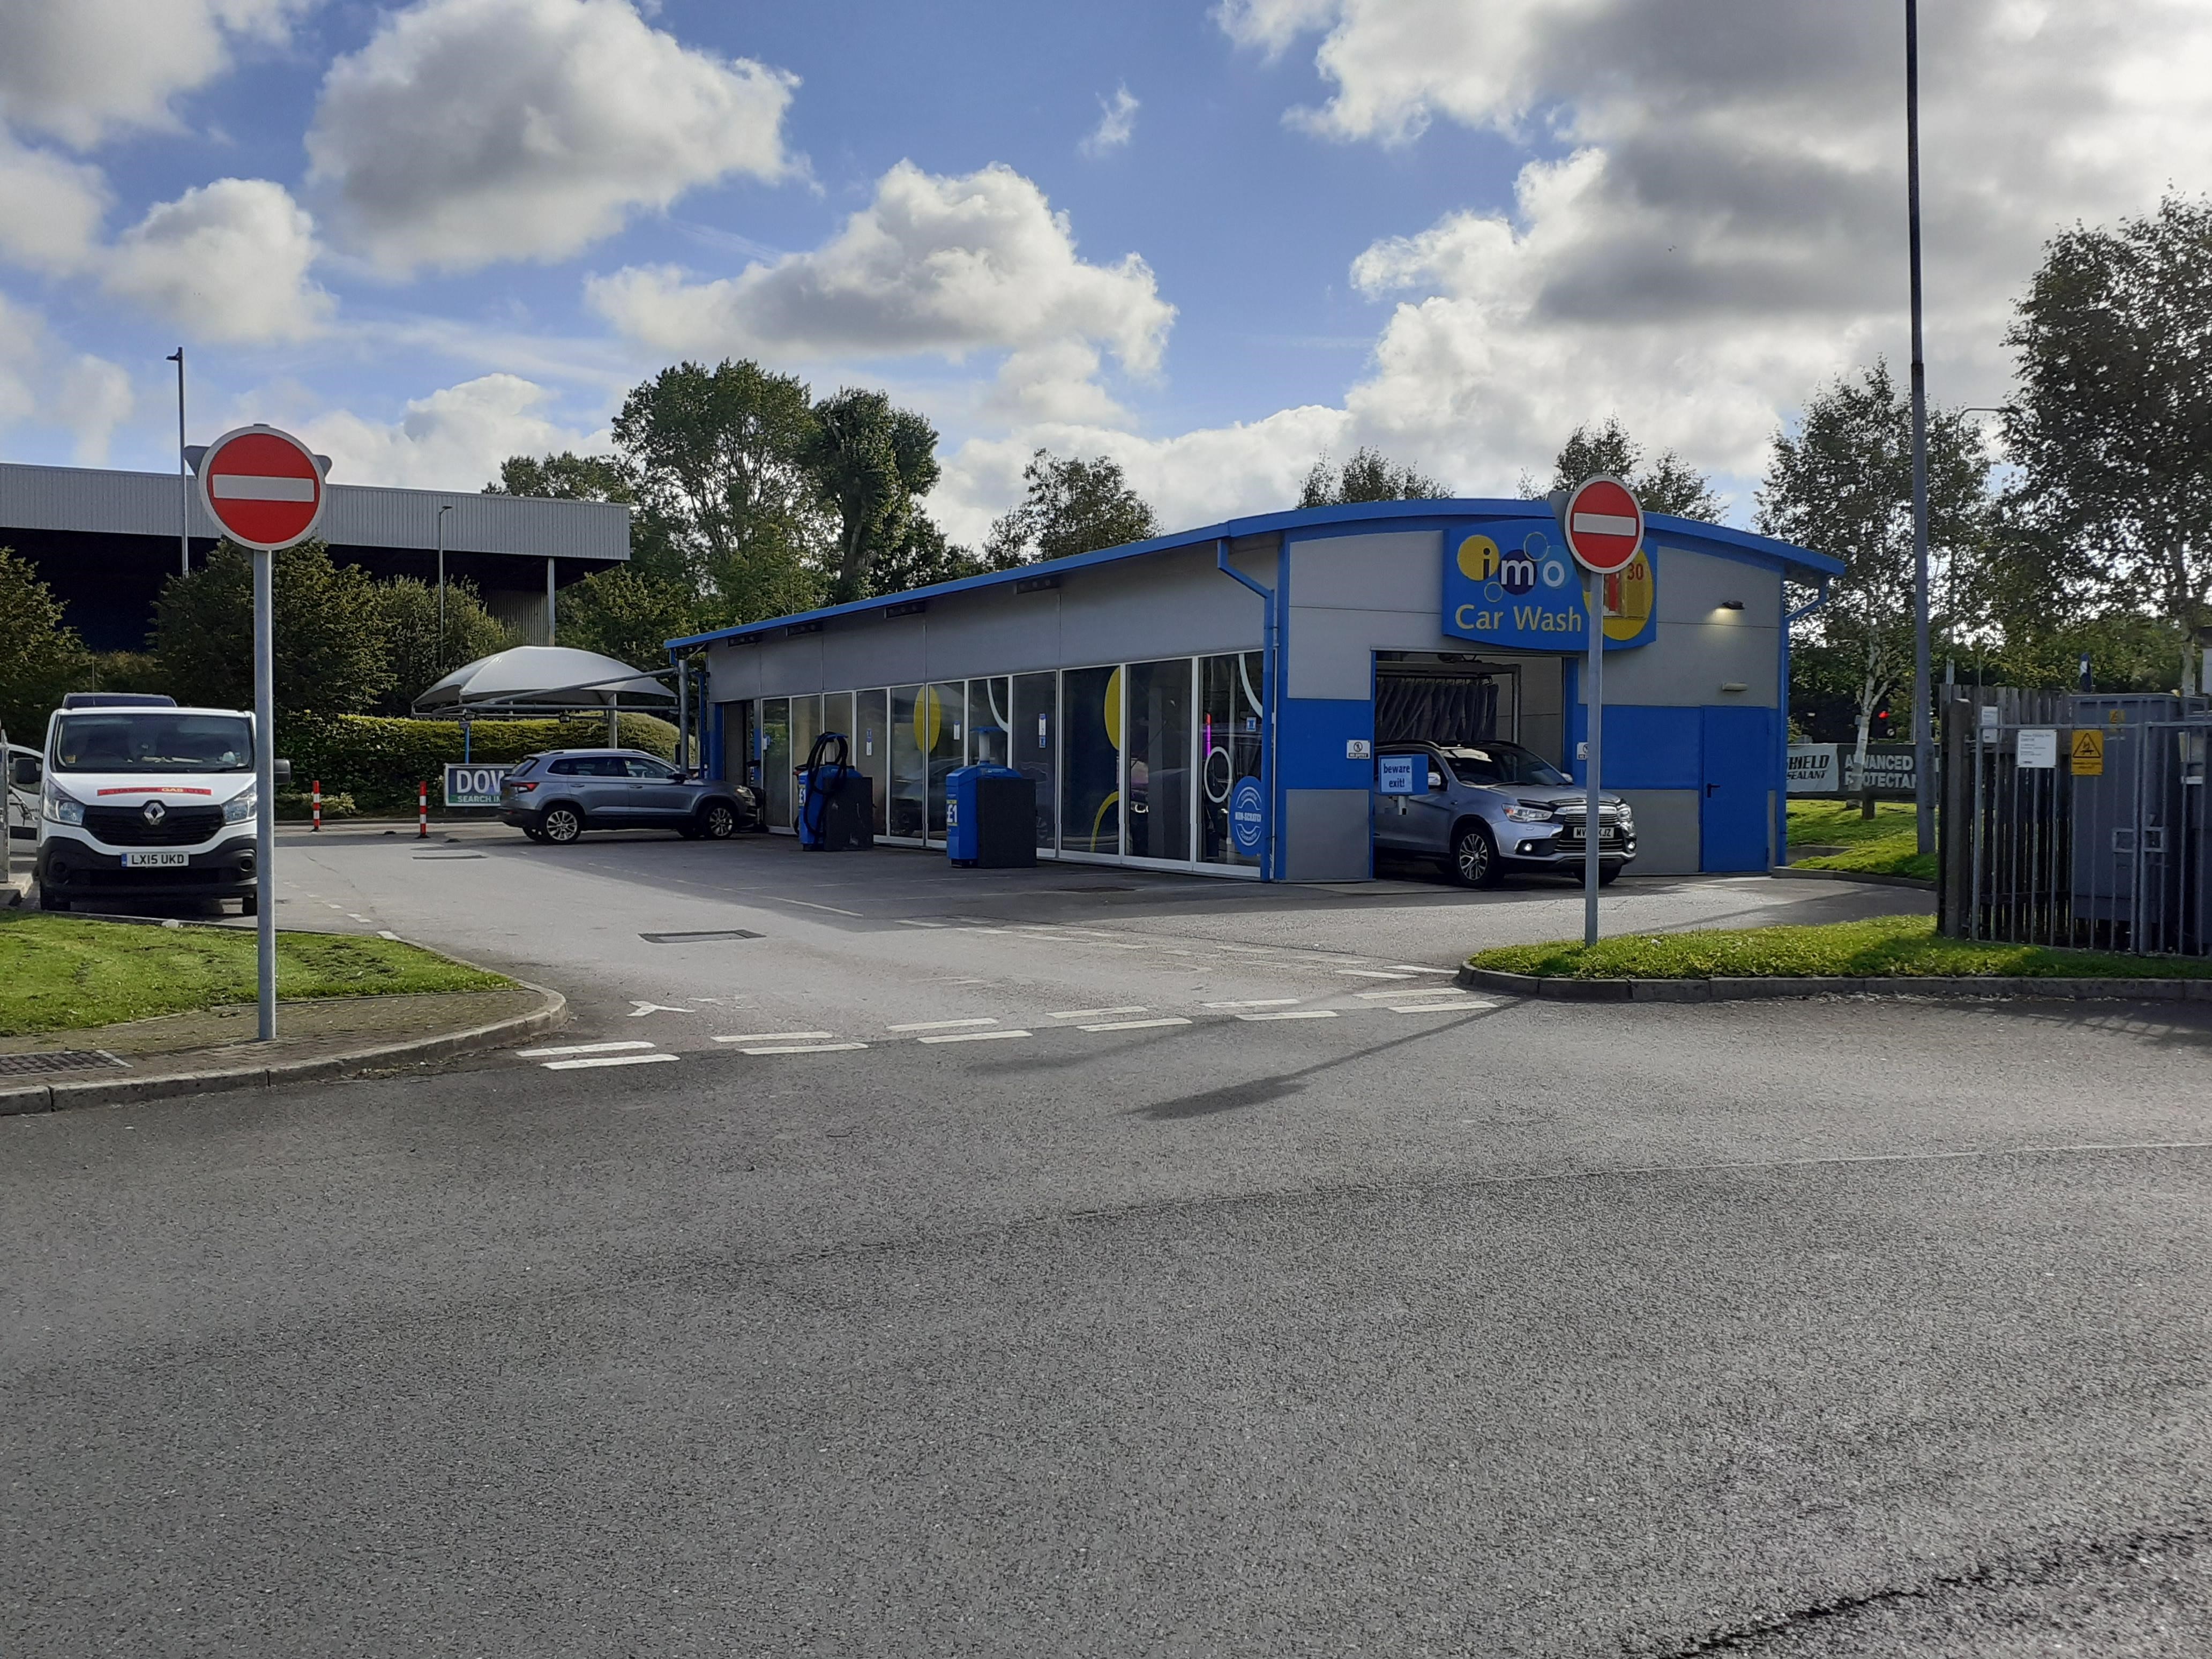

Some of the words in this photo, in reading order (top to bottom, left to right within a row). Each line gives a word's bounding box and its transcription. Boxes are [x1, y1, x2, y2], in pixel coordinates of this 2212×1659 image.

[1482, 547, 1565, 587] imo
[1455, 604, 1504, 630] Car
[1513, 606, 1582, 632] Wash
[1384, 764, 1410, 773] beware
[1845, 754, 1914, 771] AVANCED
[1389, 778, 1405, 788] exit!
[947, 804, 957, 823] £1
[131, 854, 158, 865] LX15
[161, 854, 184, 864] UKD
